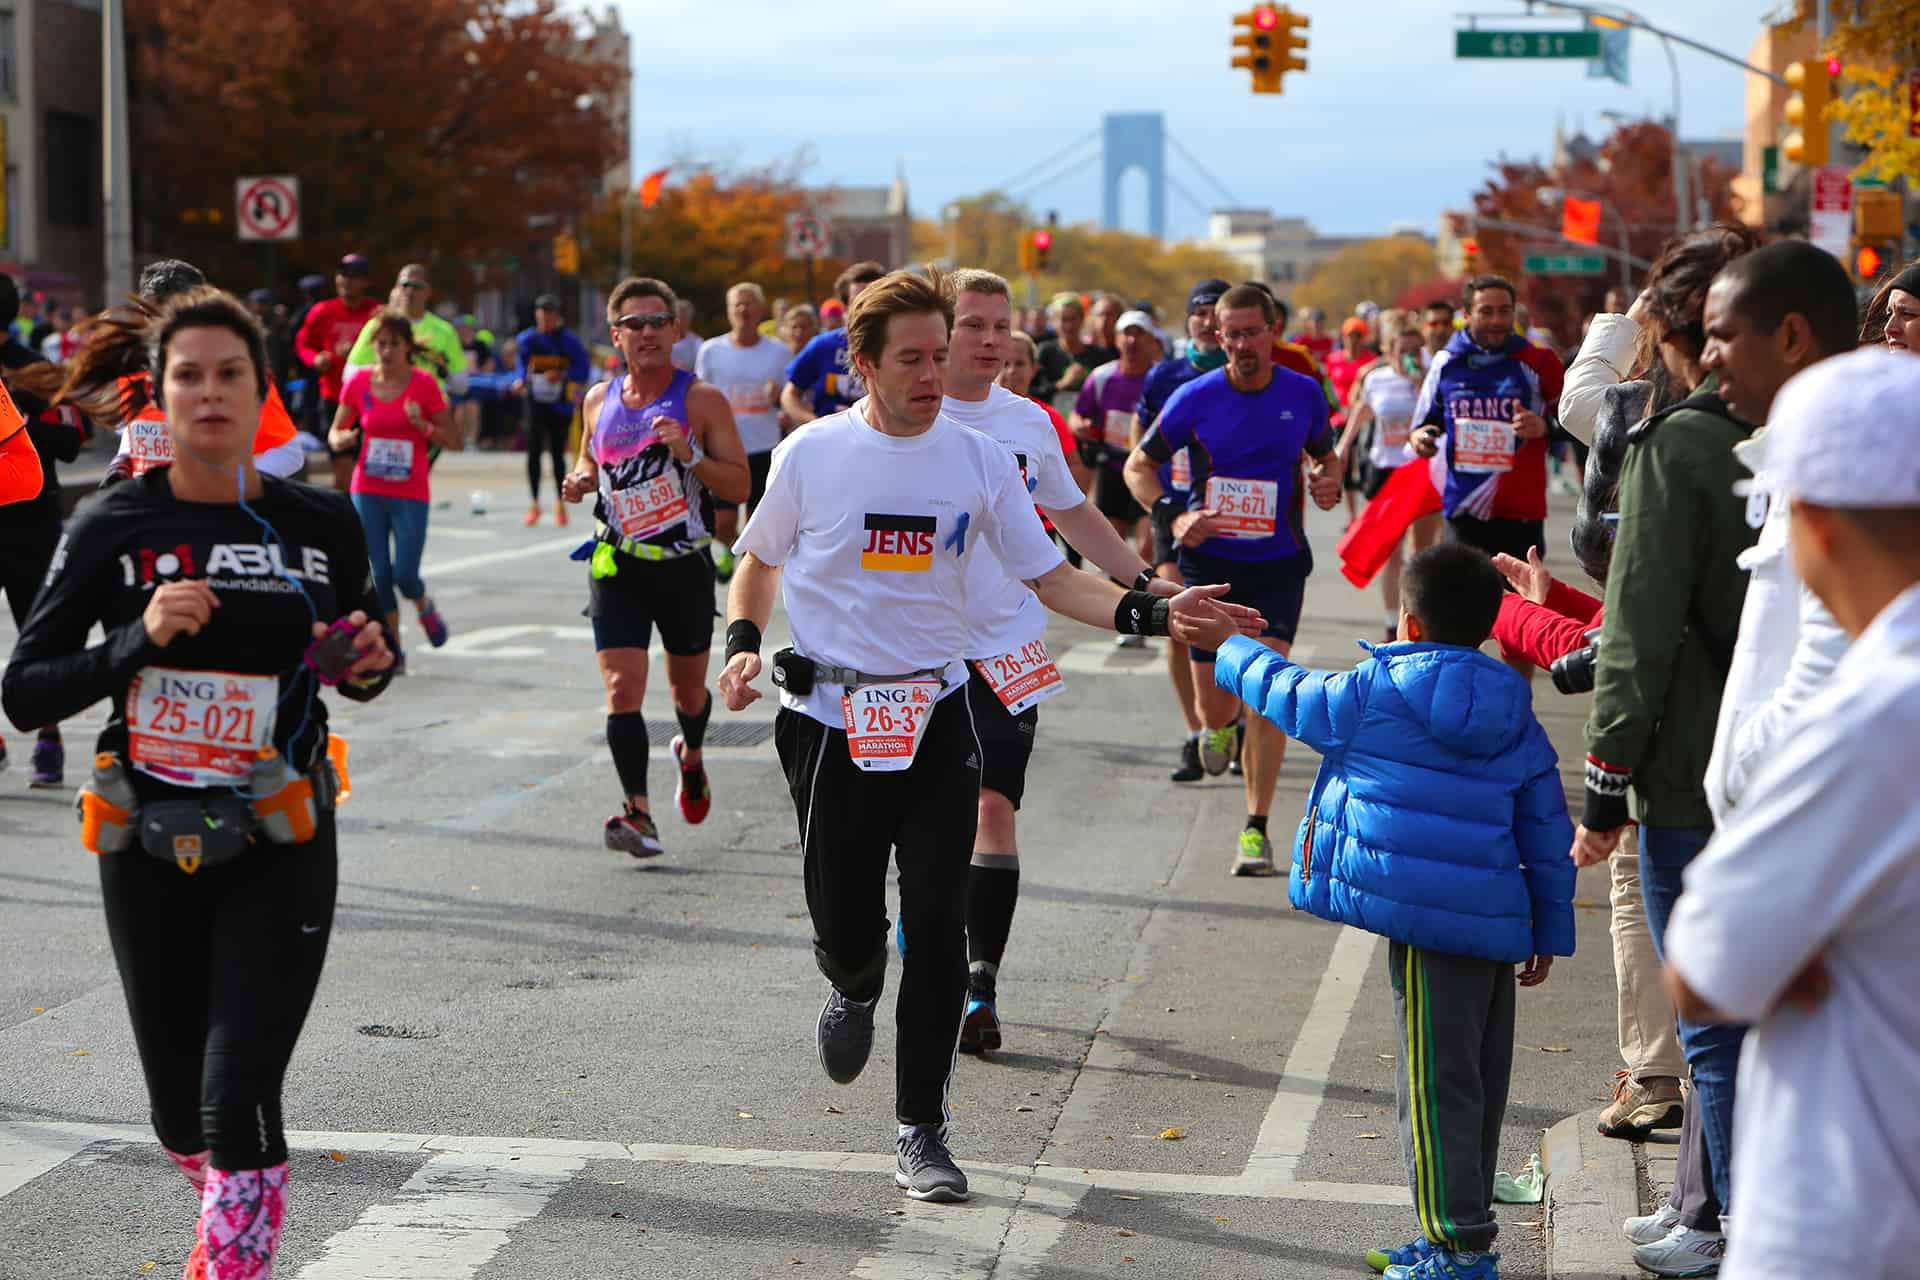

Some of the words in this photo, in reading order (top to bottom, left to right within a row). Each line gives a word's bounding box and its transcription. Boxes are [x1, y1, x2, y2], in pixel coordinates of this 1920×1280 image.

[1450, 397, 1518, 419] FRANC
[136, 423, 158, 436] ING
[1219, 482, 1248, 494] ING
[1216, 493, 1266, 516] 25-671
[862, 528, 936, 556] JENS
[159, 677, 216, 701] ING
[863, 689, 907, 703] ING
[149, 695, 256, 745] 25-021
